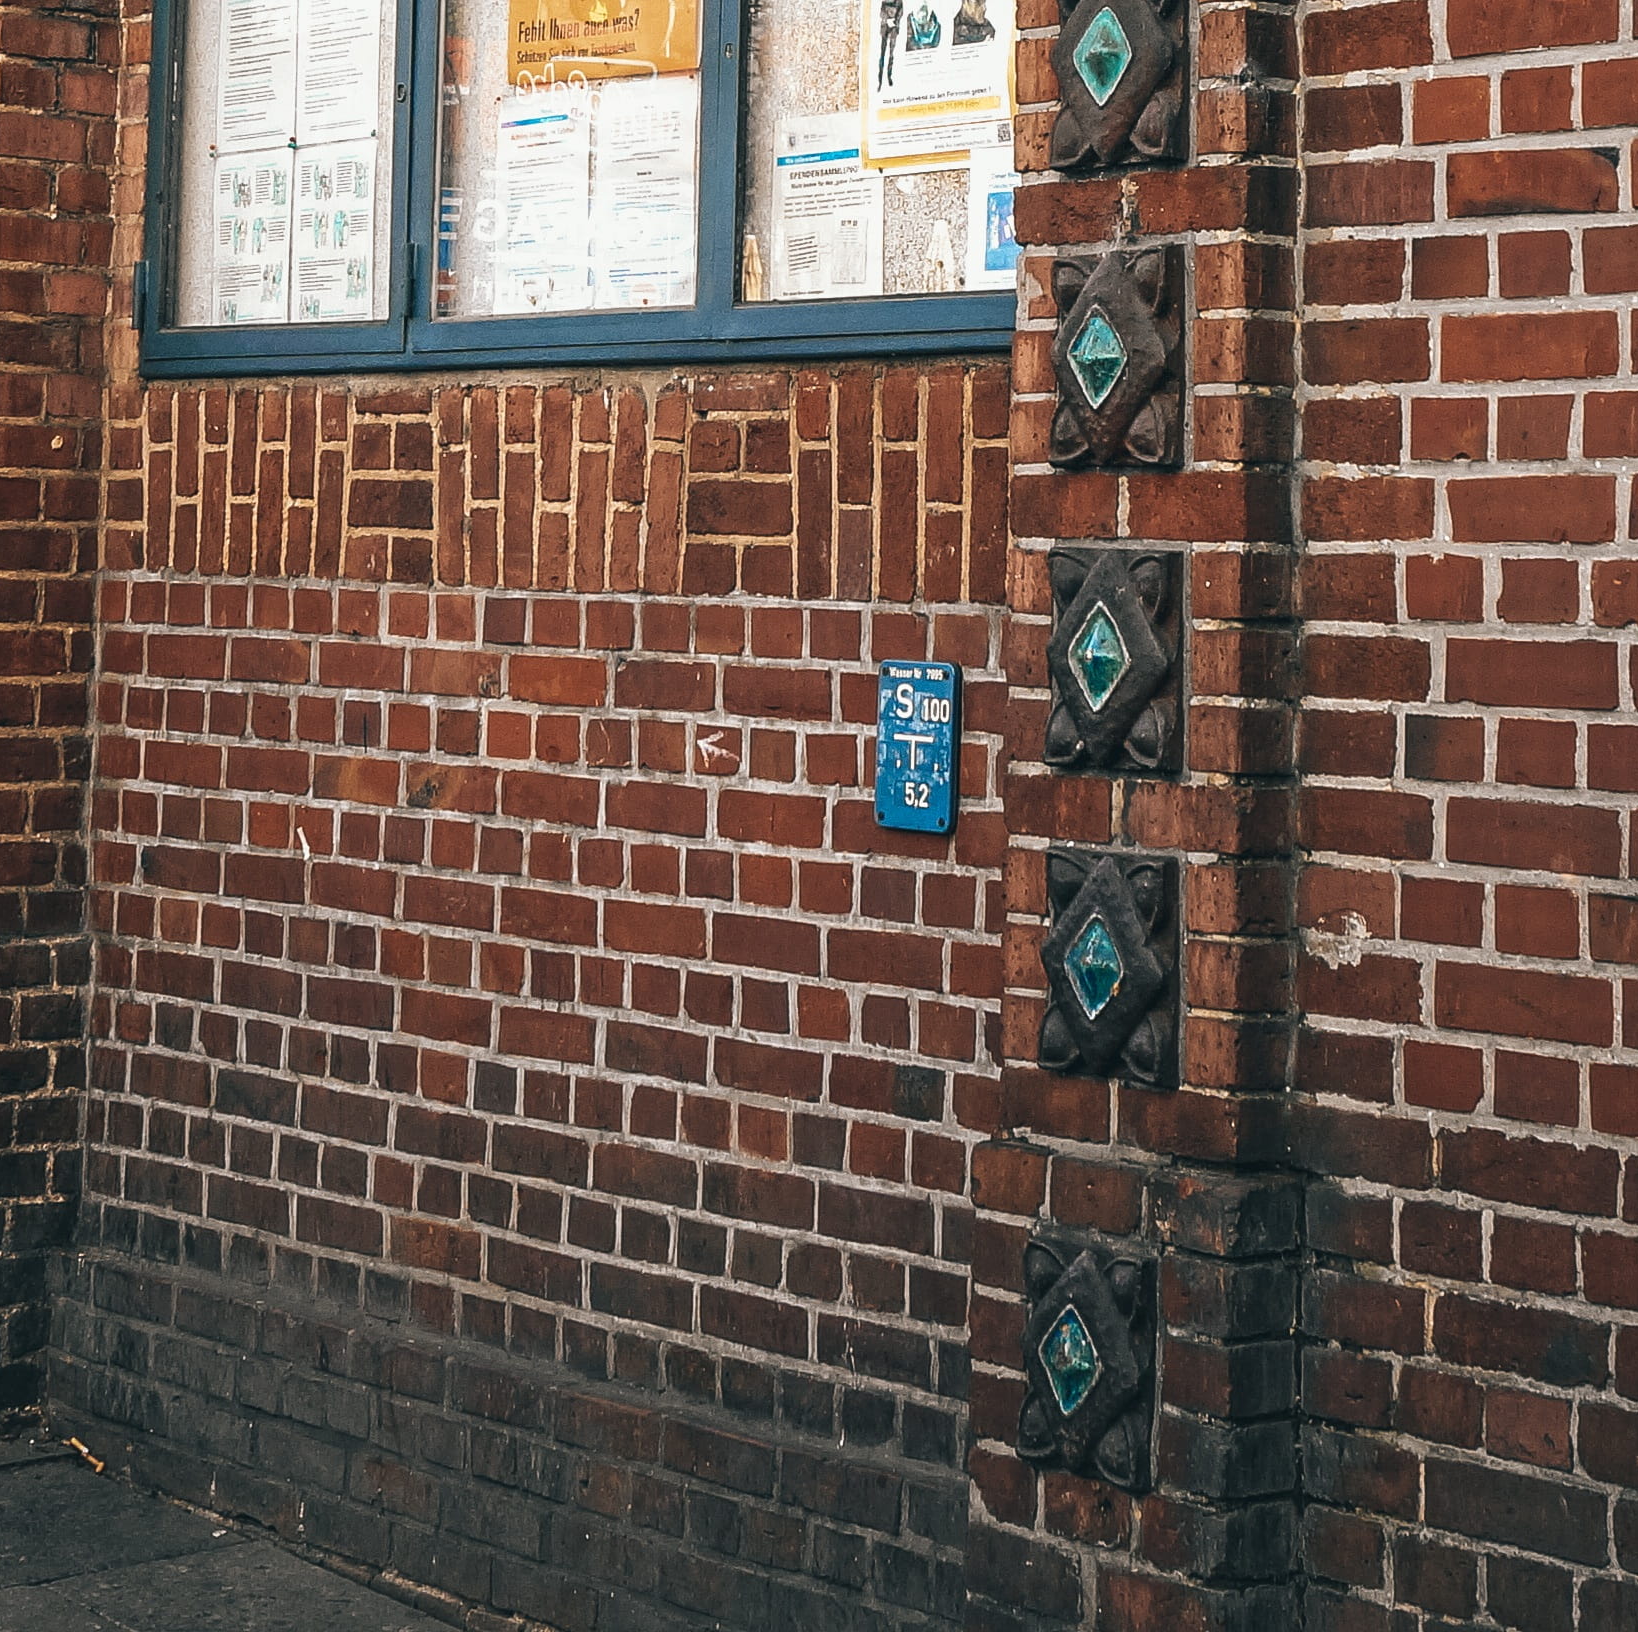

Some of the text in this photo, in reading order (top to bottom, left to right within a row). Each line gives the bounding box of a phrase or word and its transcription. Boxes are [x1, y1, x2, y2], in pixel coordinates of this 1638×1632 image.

[518, 8, 640, 43] Fehlt Ihnen auch was?
[896, 683, 950, 723] S 100
[904, 781, 929, 808] 5,2
